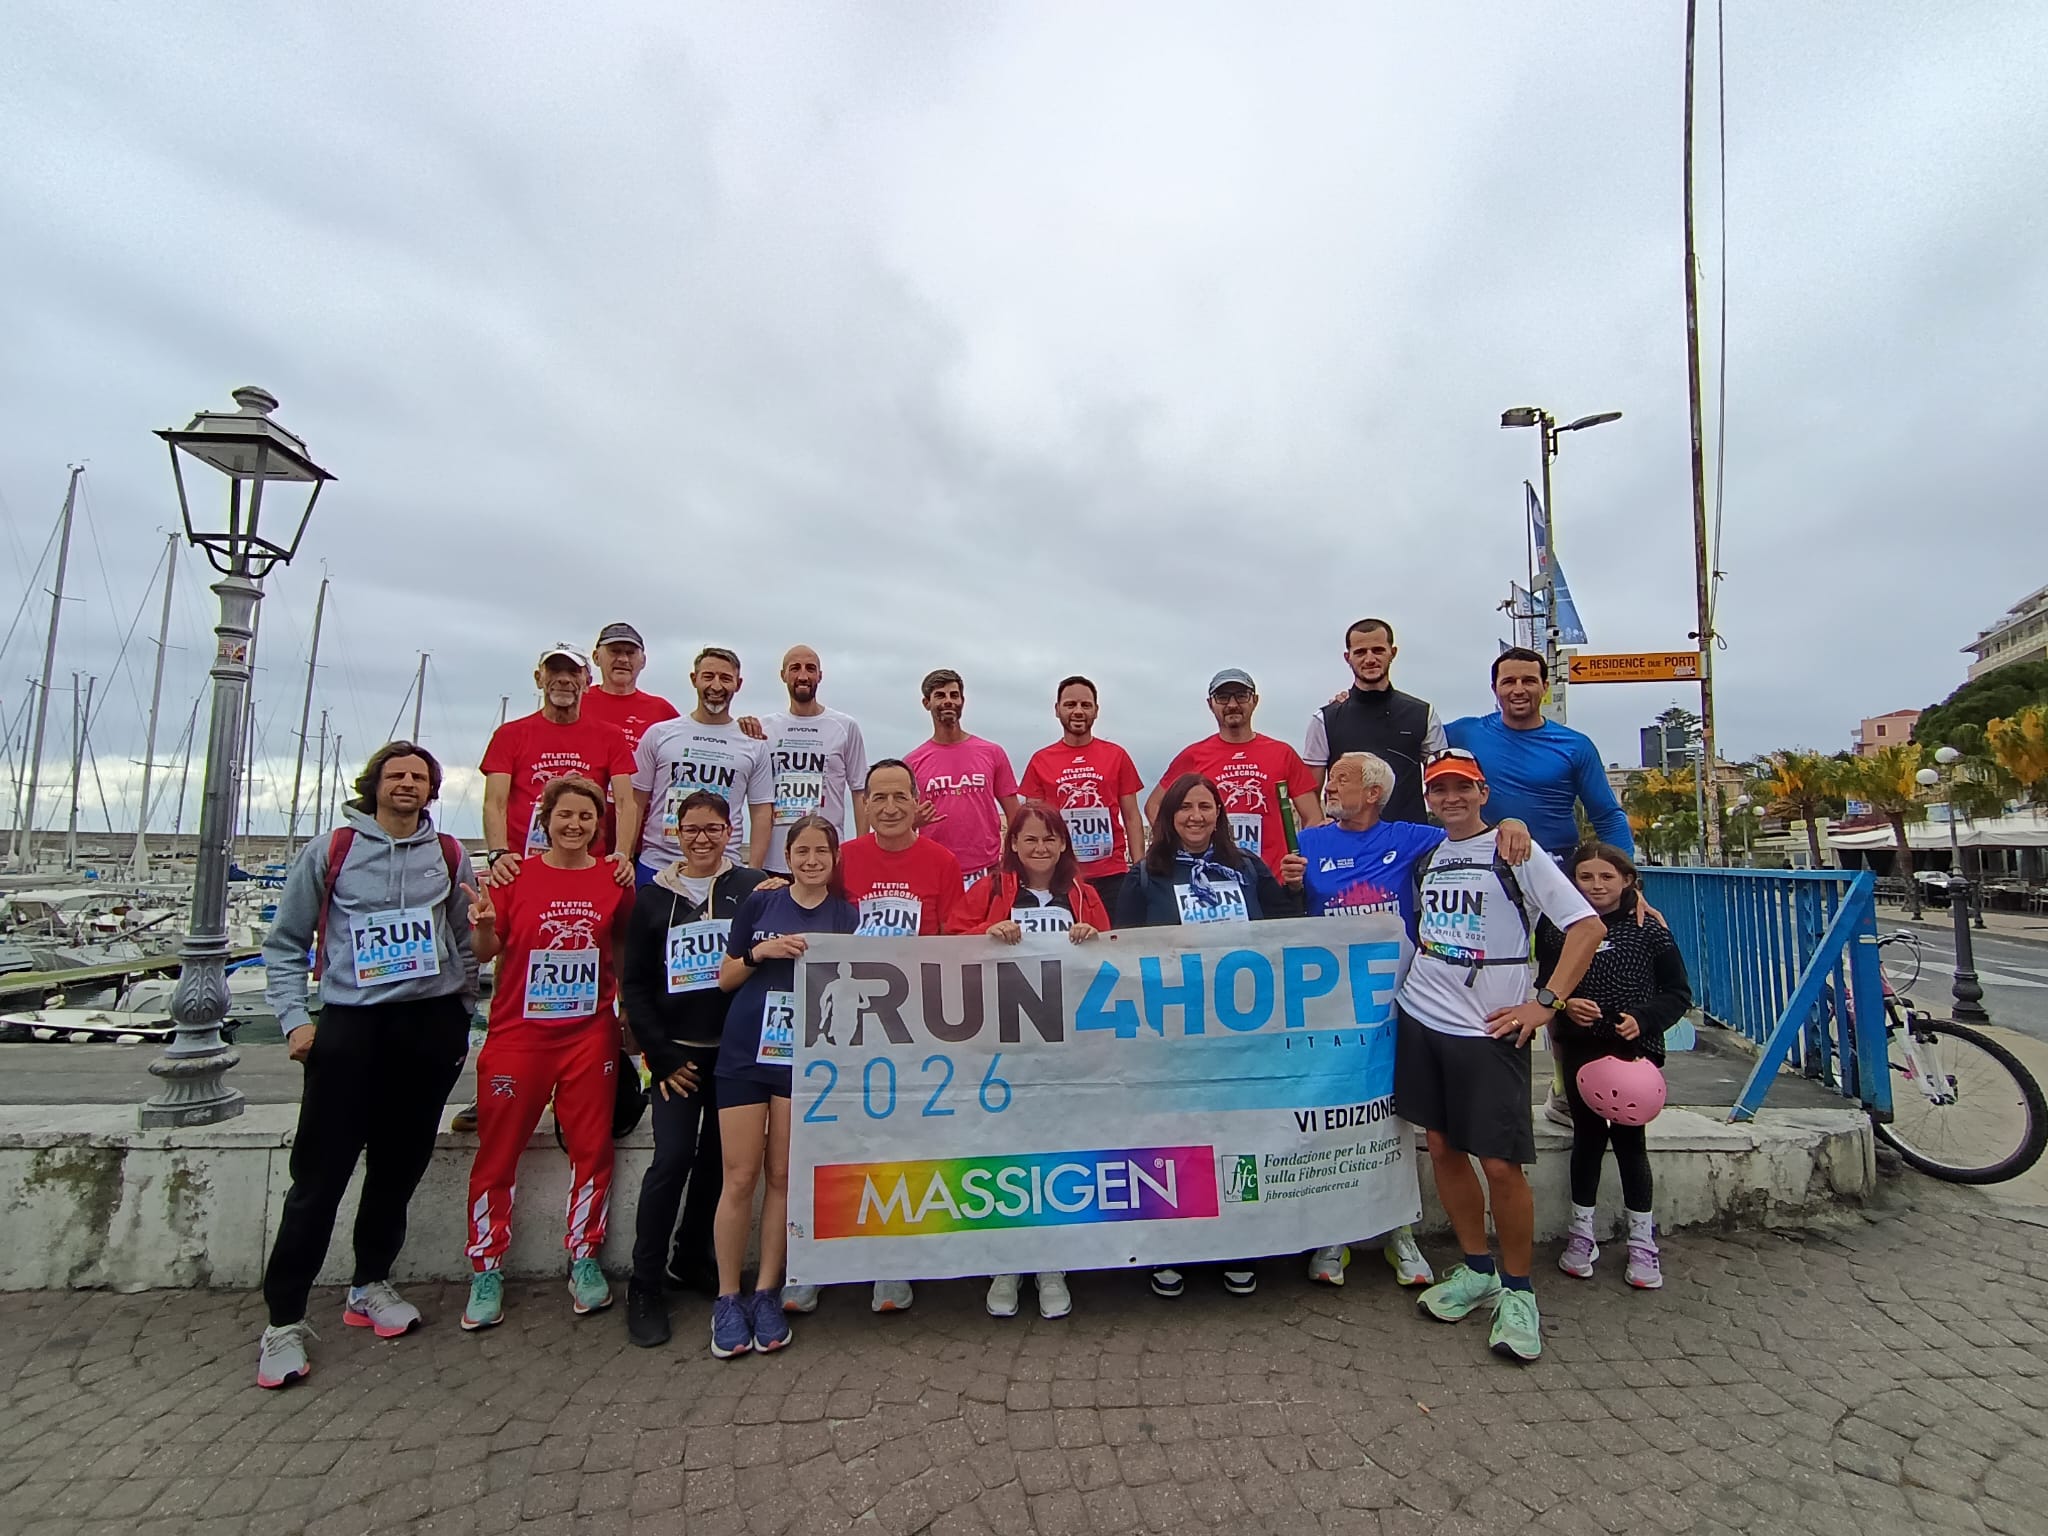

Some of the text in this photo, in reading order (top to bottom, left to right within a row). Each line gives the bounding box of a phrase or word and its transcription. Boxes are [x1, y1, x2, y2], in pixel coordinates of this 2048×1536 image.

[1589, 658, 1645, 669] RESIDENCE
[1664, 656, 1696, 667] PORTI
[531, 759, 590, 771] VALLECROSIA
[540, 752, 581, 760] ATLETICA
[770, 751, 825, 773] RUN
[671, 761, 737, 788] RUN
[1062, 766, 1095, 774] ATLETICA
[1215, 770, 1268, 782] VALLECROSIA
[1223, 763, 1259, 771] ATLETICA
[926, 773, 985, 792] ATLAS
[1055, 773, 1104, 784] VALLECROSIA
[775, 782, 819, 799] RUN
[1065, 817, 1110, 835] RUN
[862, 890, 918, 902] VALLECROSIA
[1420, 889, 1483, 916] RUN
[539, 908, 602, 921] VALLECROSIA
[860, 908, 918, 930] RUN
[1184, 903, 1245, 921] 4HOPE
[354, 920, 432, 951] RUN
[357, 939, 433, 964] 4HOPE
[530, 962, 596, 984] RUN
[529, 983, 596, 996] 4HOPE
[1286, 1025, 1392, 1051] ITALIA
[803, 1052, 1012, 1124] 2026
[1294, 1095, 1397, 1132] VI EDIZIONE
[1264, 1136, 1401, 1168] Fondazione per la Ricerca
[1264, 1169, 1296, 1185] sulla
[1298, 1162, 1337, 1182] Fibrosi
